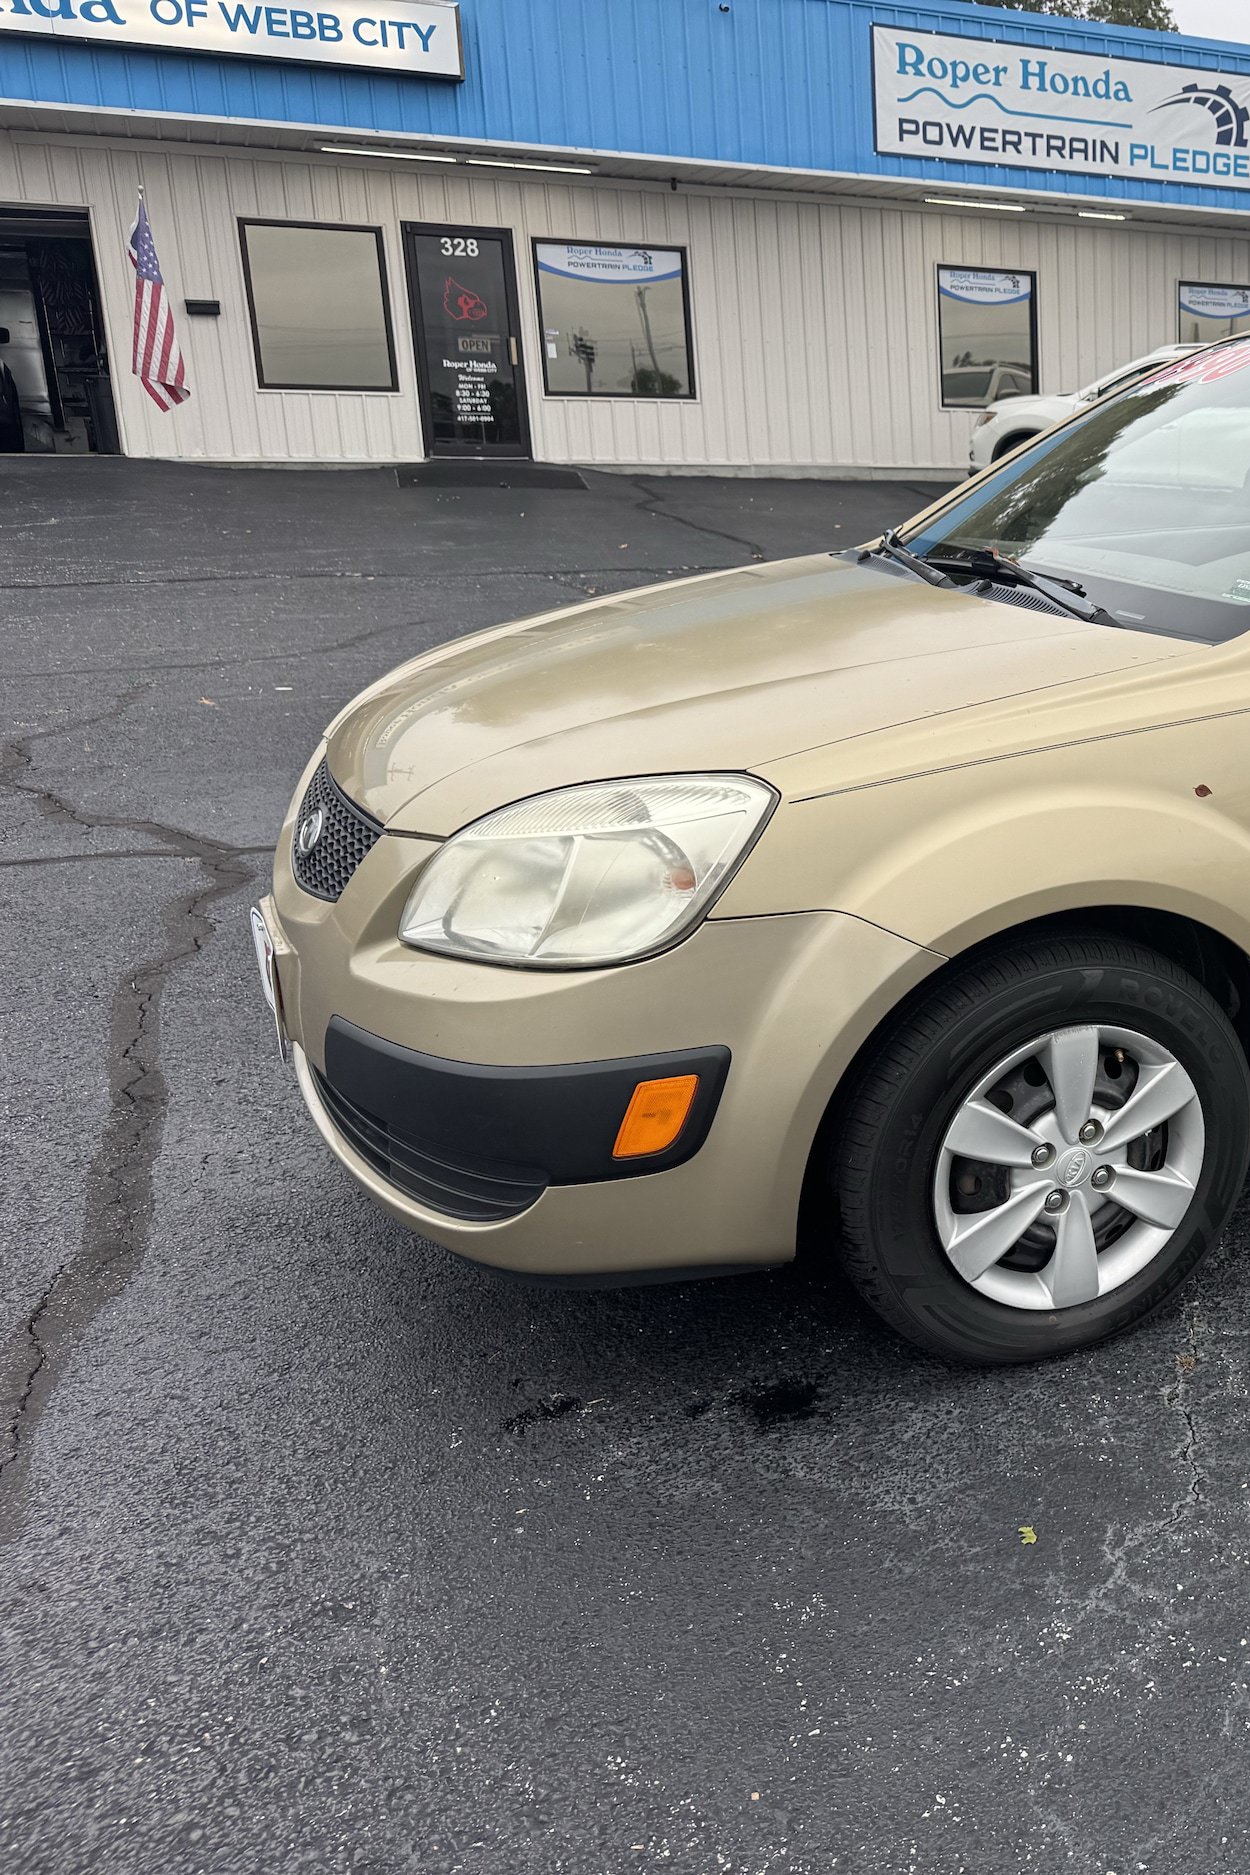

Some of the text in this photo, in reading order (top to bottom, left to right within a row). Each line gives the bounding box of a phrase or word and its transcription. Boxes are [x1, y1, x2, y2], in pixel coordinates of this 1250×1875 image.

[150, 0, 207, 27] OF
[217, 2, 344, 42] WEBB
[352, 17, 437, 52] CITY
[895, 42, 1133, 102] Roper Honda
[898, 117, 1250, 178] POWERTRAIN PLEDGE
[440, 237, 479, 257] 328
[566, 246, 623, 257] Roper Honda
[567, 261, 621, 270] POWERTRAIN
[461, 339, 489, 351] OPEN
[442, 359, 497, 369] Roper Honda
